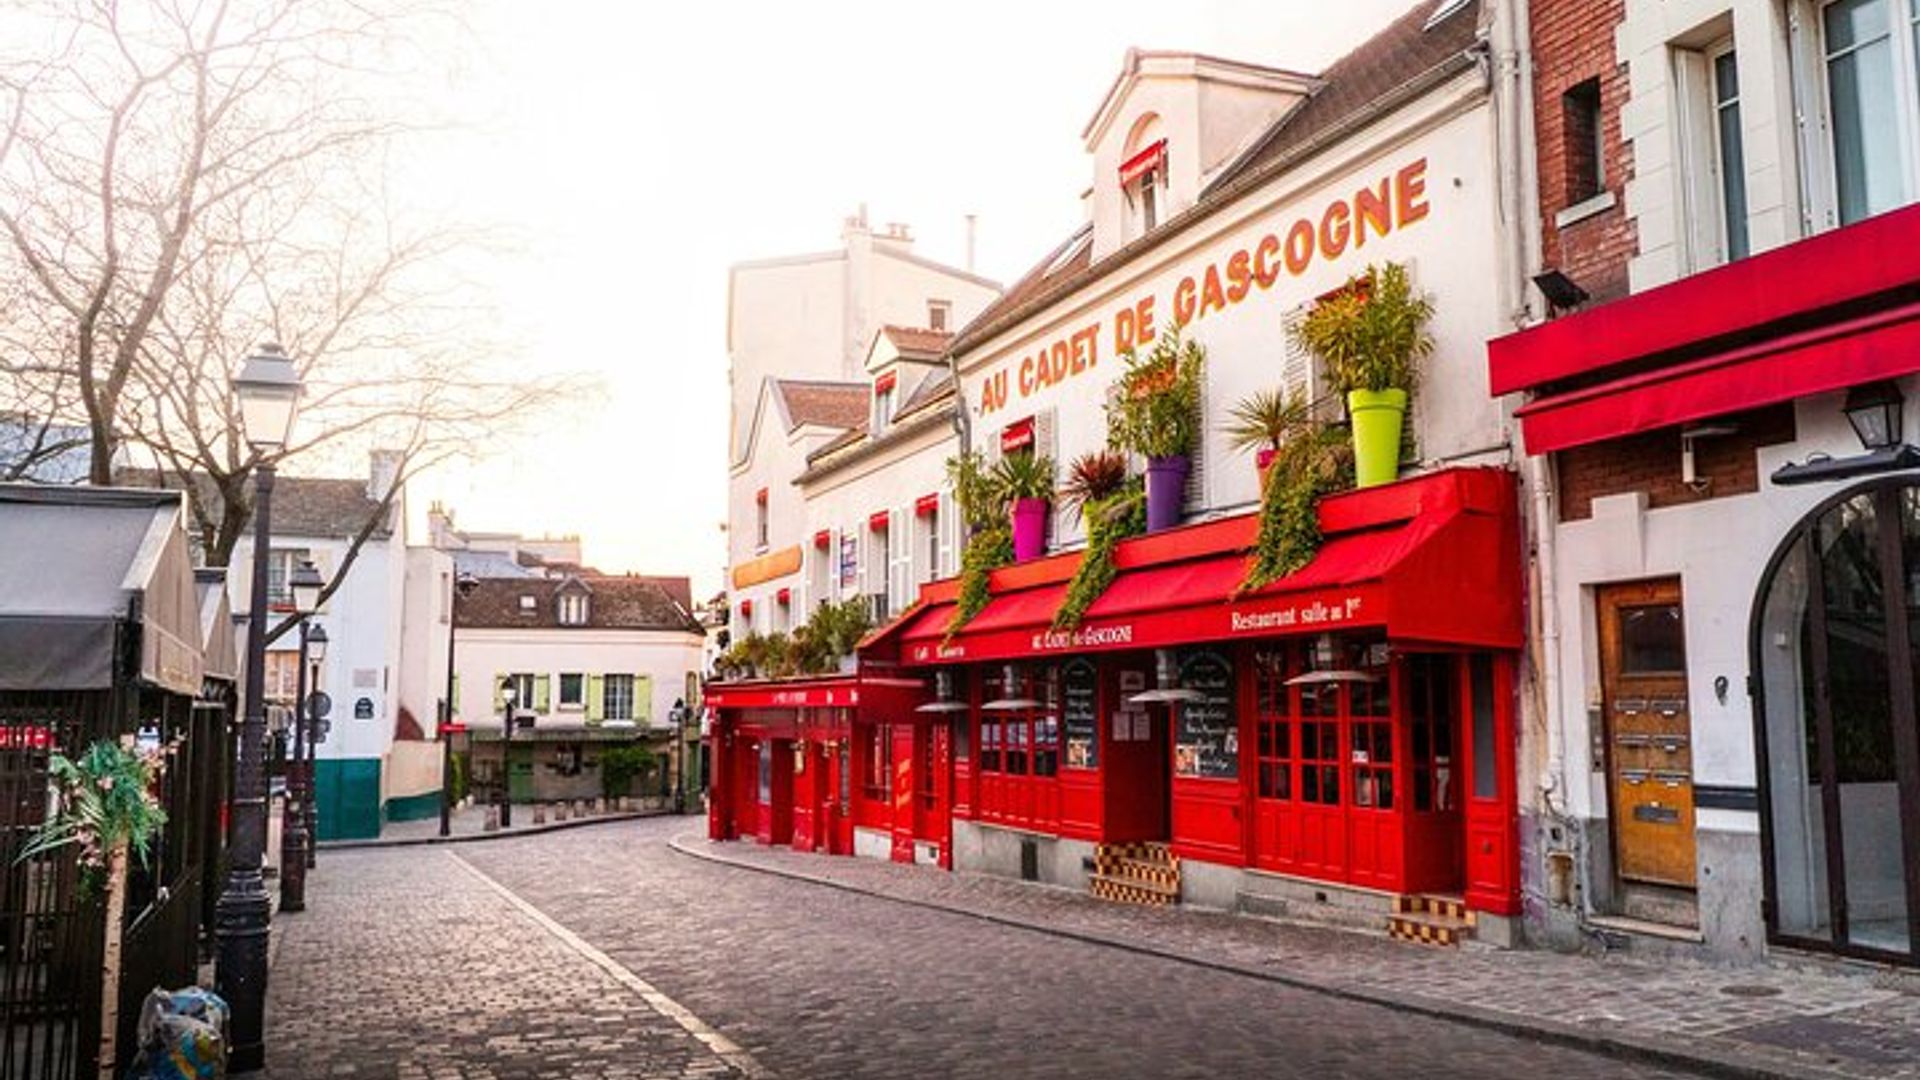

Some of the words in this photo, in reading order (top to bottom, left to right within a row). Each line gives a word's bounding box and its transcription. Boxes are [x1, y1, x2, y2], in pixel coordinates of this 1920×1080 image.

[980, 369, 1007, 417] AU
[1018, 322, 1100, 398] CADET
[1115, 294, 1156, 356] DE
[1173, 157, 1430, 328] GASCOGNE
[1231, 607, 1296, 632] Restaurant
